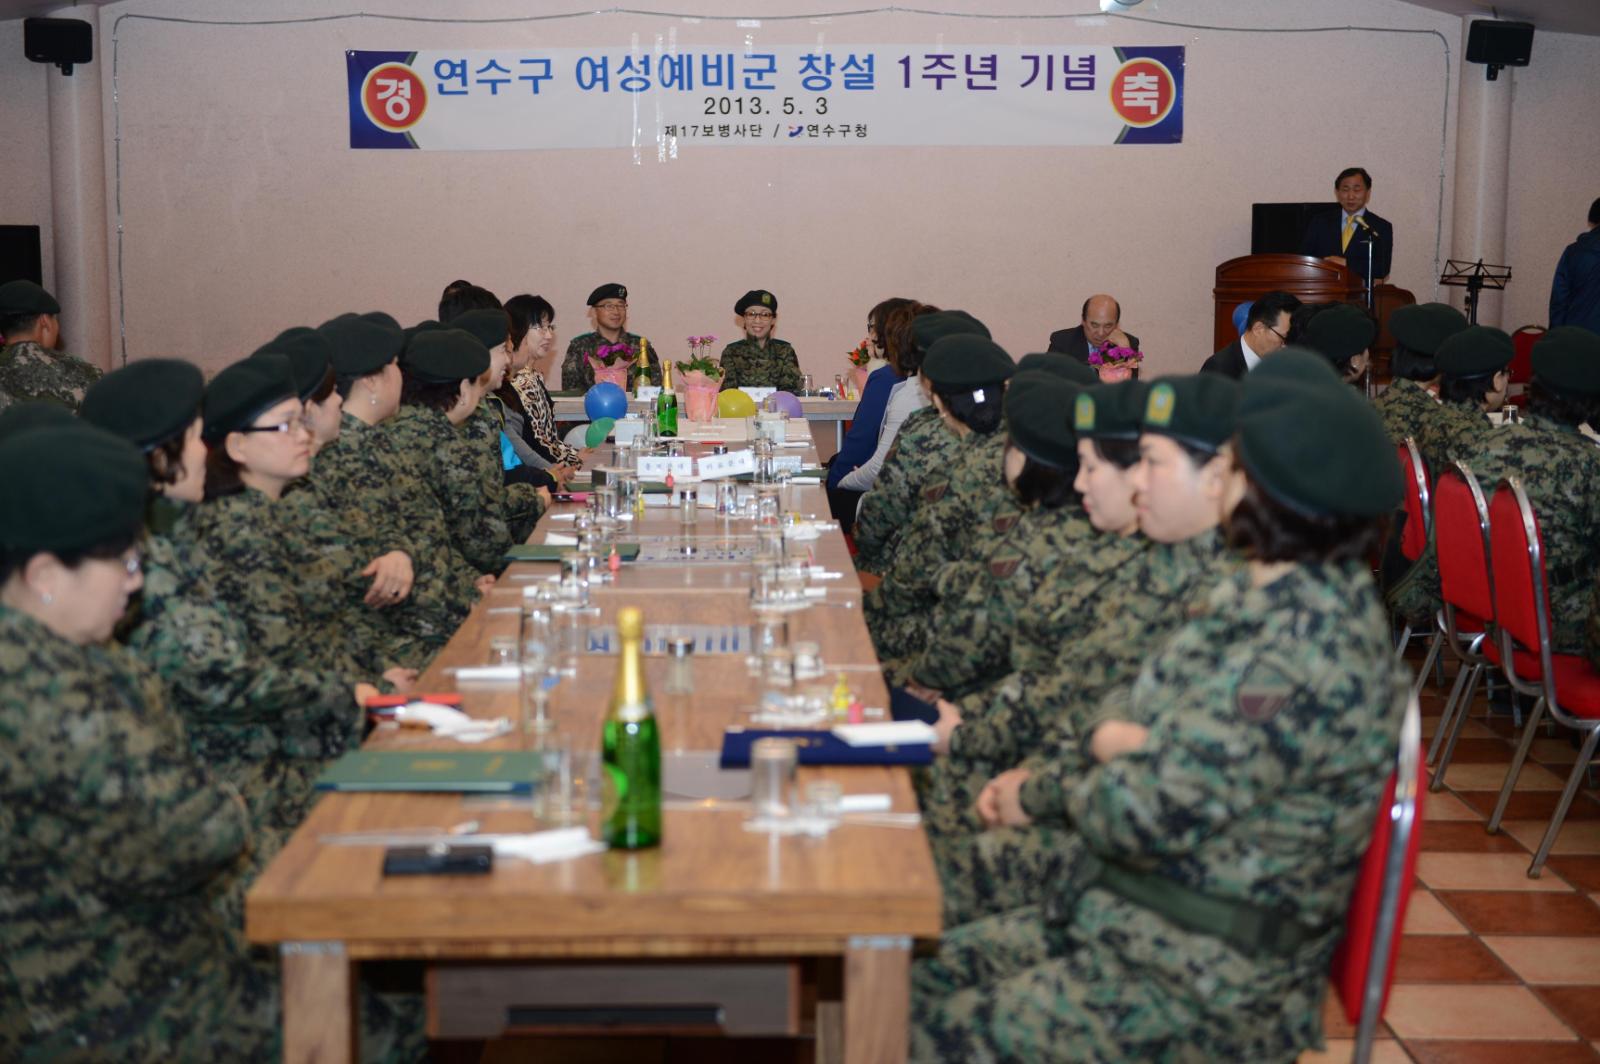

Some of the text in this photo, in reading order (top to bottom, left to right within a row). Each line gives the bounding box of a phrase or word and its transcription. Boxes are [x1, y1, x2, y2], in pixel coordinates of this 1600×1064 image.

[432, 52, 1097, 96] 연수구 여성예비군 창설 1주년 기념
[1121, 71, 1160, 116] 축
[375, 78, 411, 121] 경
[703, 96, 828, 115] 2013. 5. 3
[664, 123, 763, 138] 제17보병사단
[806, 123, 868, 138] 연수구청
